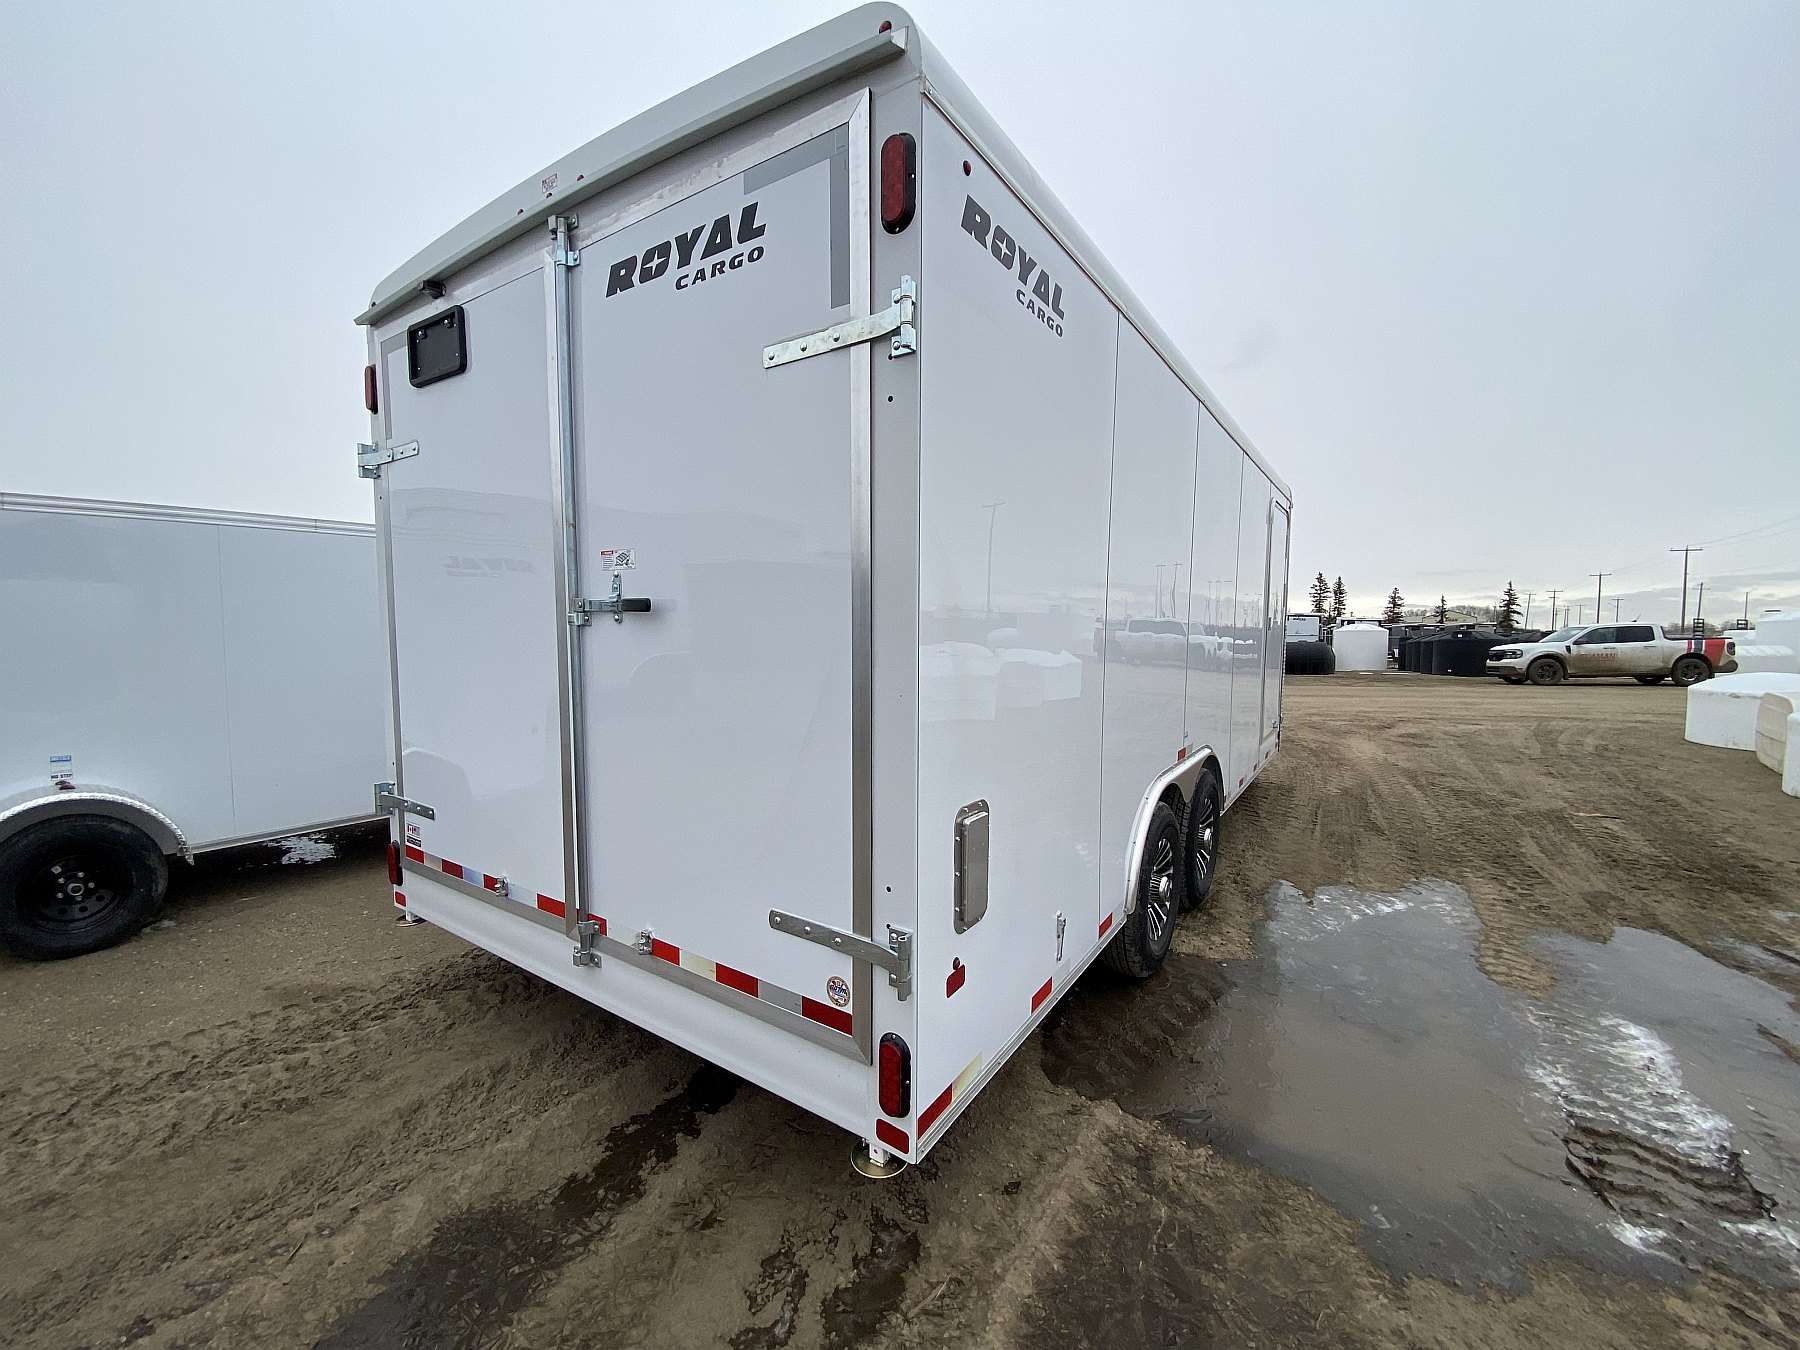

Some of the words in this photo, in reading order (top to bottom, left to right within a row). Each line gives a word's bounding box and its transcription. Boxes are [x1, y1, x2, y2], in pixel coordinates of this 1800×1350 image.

[606, 201, 767, 298] ROYAL
[675, 246, 765, 290] CARGO
[961, 194, 1065, 320] ROYAL
[1016, 289, 1063, 338] CARGO
